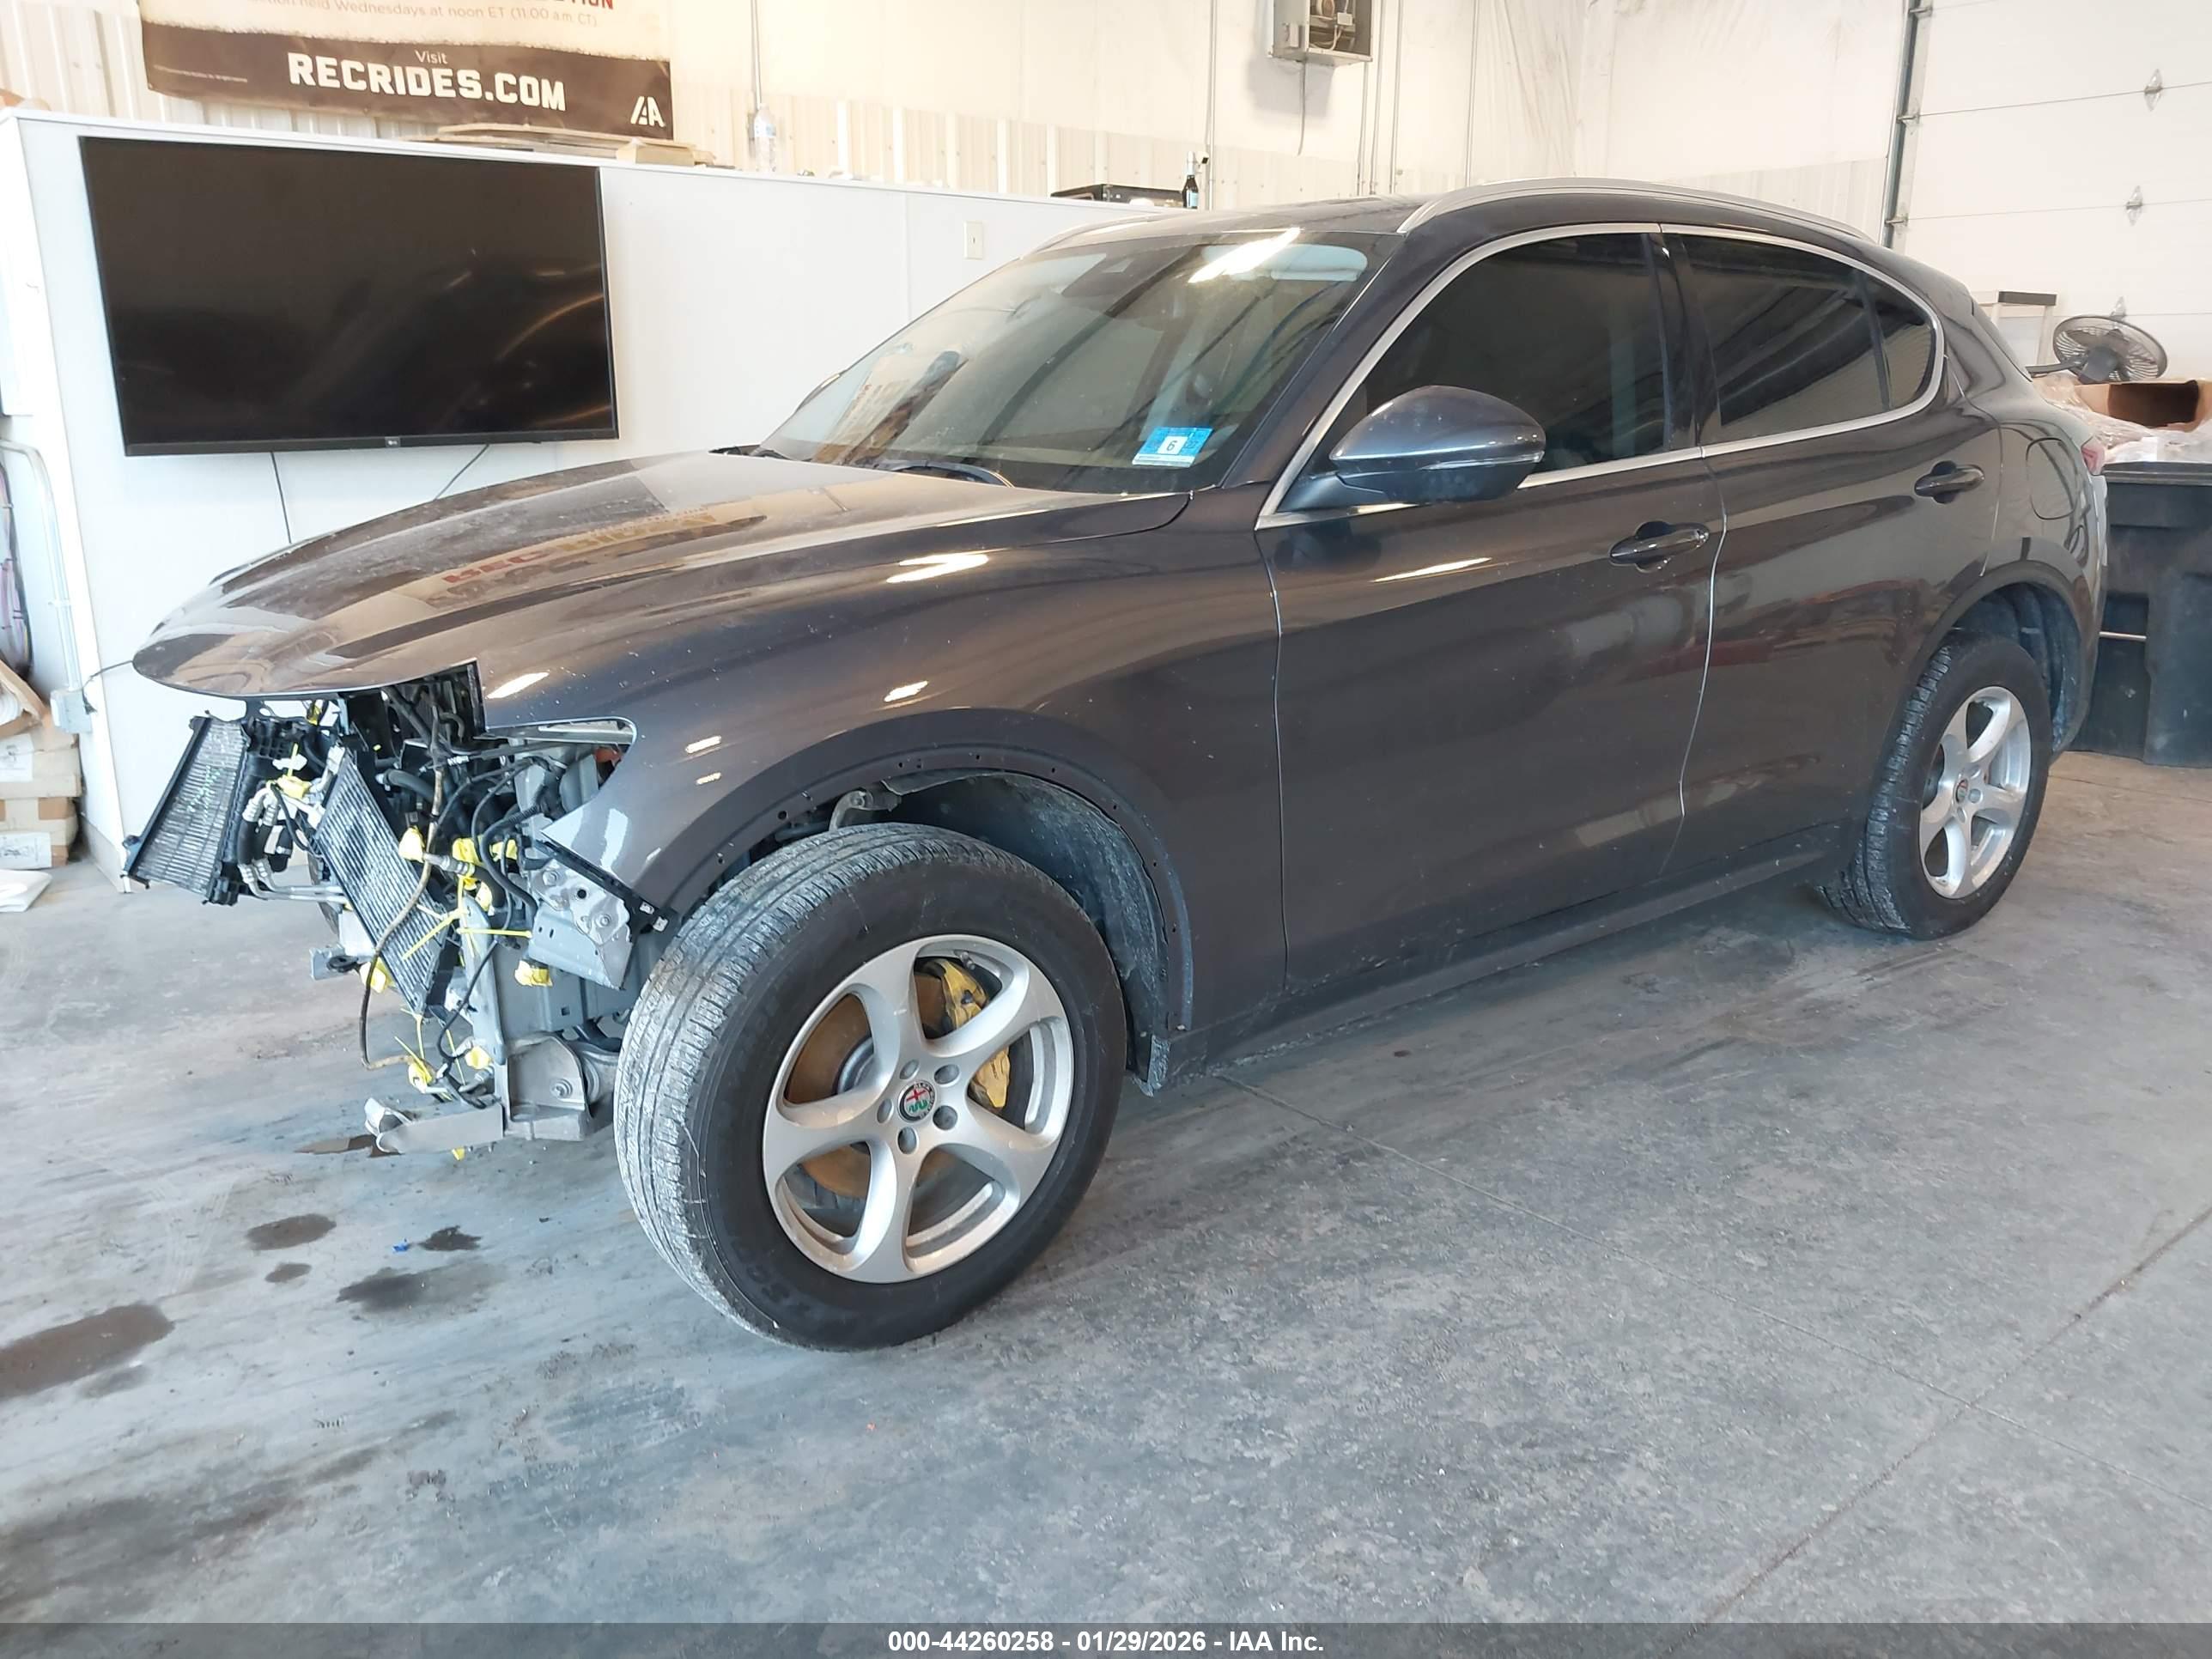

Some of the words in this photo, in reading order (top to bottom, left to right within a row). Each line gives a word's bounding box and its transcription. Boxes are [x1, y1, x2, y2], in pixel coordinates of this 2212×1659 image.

[335, 0, 426, 18] Wednesdays
[430, 6, 443, 16] at
[448, 7, 484, 18] noon
[488, 6, 504, 18] ET
[415, 50, 448, 64] Visit
[288, 52, 566, 111] RECRIDES.COM
[1166, 440, 1178, 452] 6
